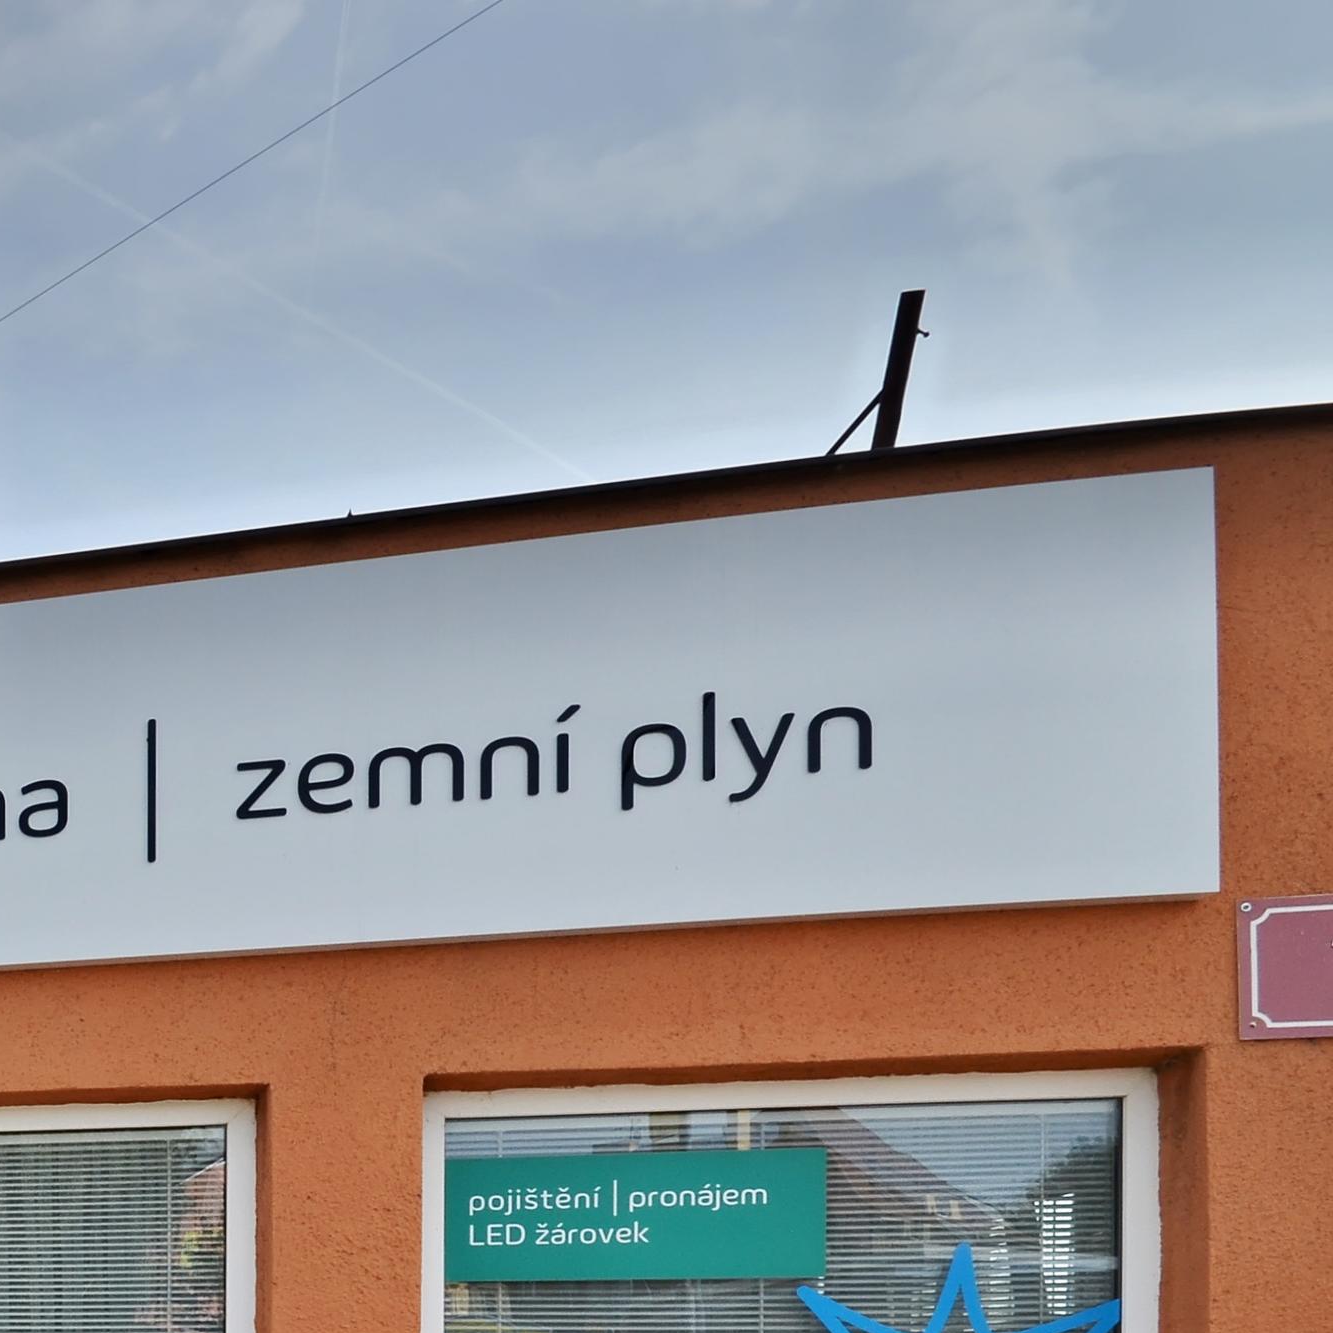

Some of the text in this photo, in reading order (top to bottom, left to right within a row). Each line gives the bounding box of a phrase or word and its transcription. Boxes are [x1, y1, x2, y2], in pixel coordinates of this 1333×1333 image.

[235, 704, 581, 820] zemní
[620, 691, 873, 812] plyn
[469, 1183, 768, 1216] pojištění pronájem
[469, 1220, 649, 1246] LED žárovek
